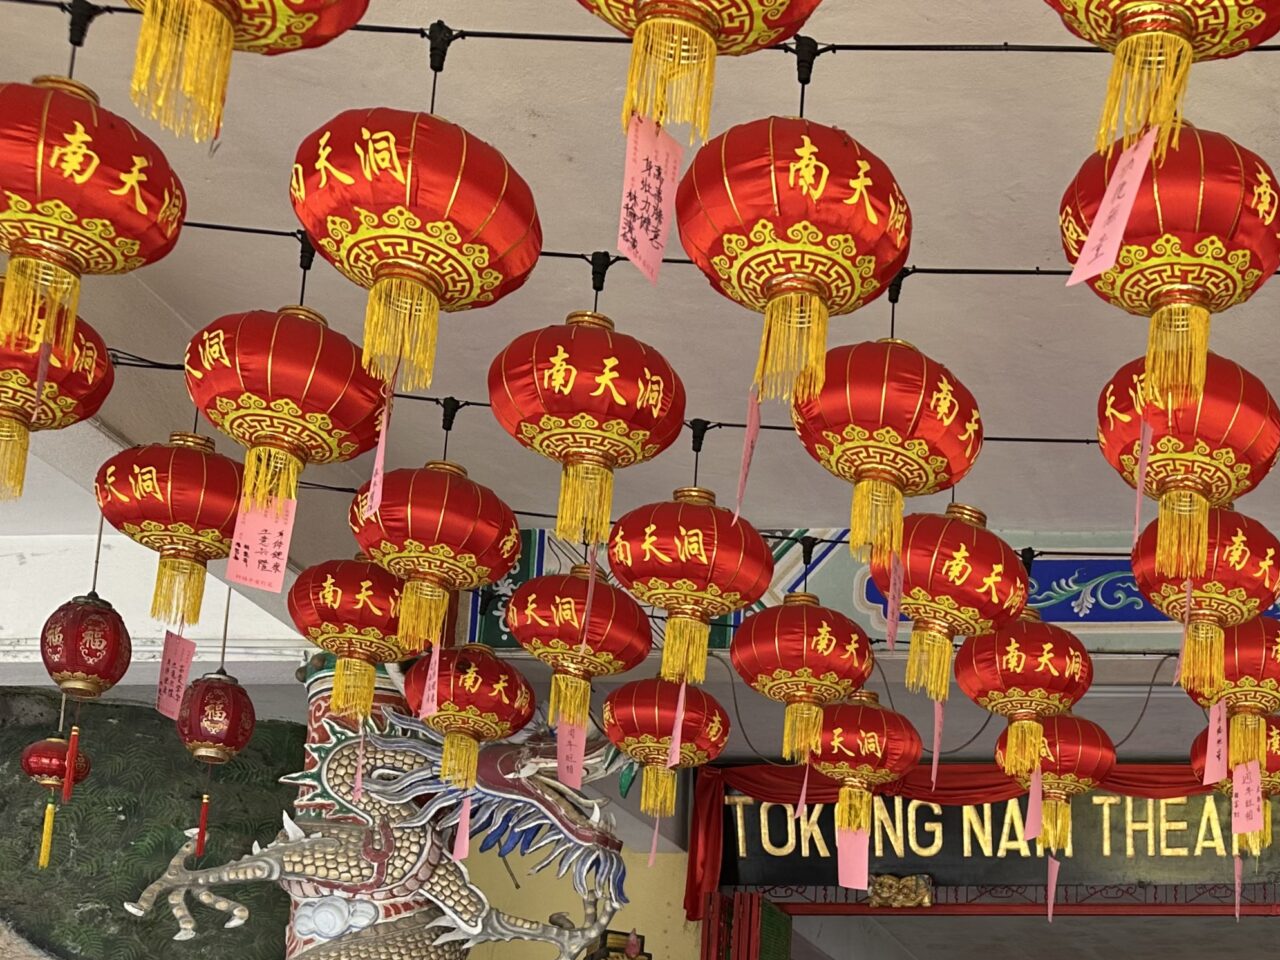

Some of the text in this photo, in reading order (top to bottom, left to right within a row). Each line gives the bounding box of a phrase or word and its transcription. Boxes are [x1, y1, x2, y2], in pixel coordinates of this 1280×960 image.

[789, 135, 907, 248] 南天洞
[544, 345, 663, 418] 南天洞
[613, 524, 708, 567] 南天洞
[46, 626, 64, 646] 福
[82, 631, 107, 650] 福
[1002, 637, 1082, 681] 南天洞
[204, 705, 226, 721] 福
[724, 795, 943, 857] TOKNG
[963, 796, 1073, 857] NA
[1091, 795, 1260, 857] THEA
